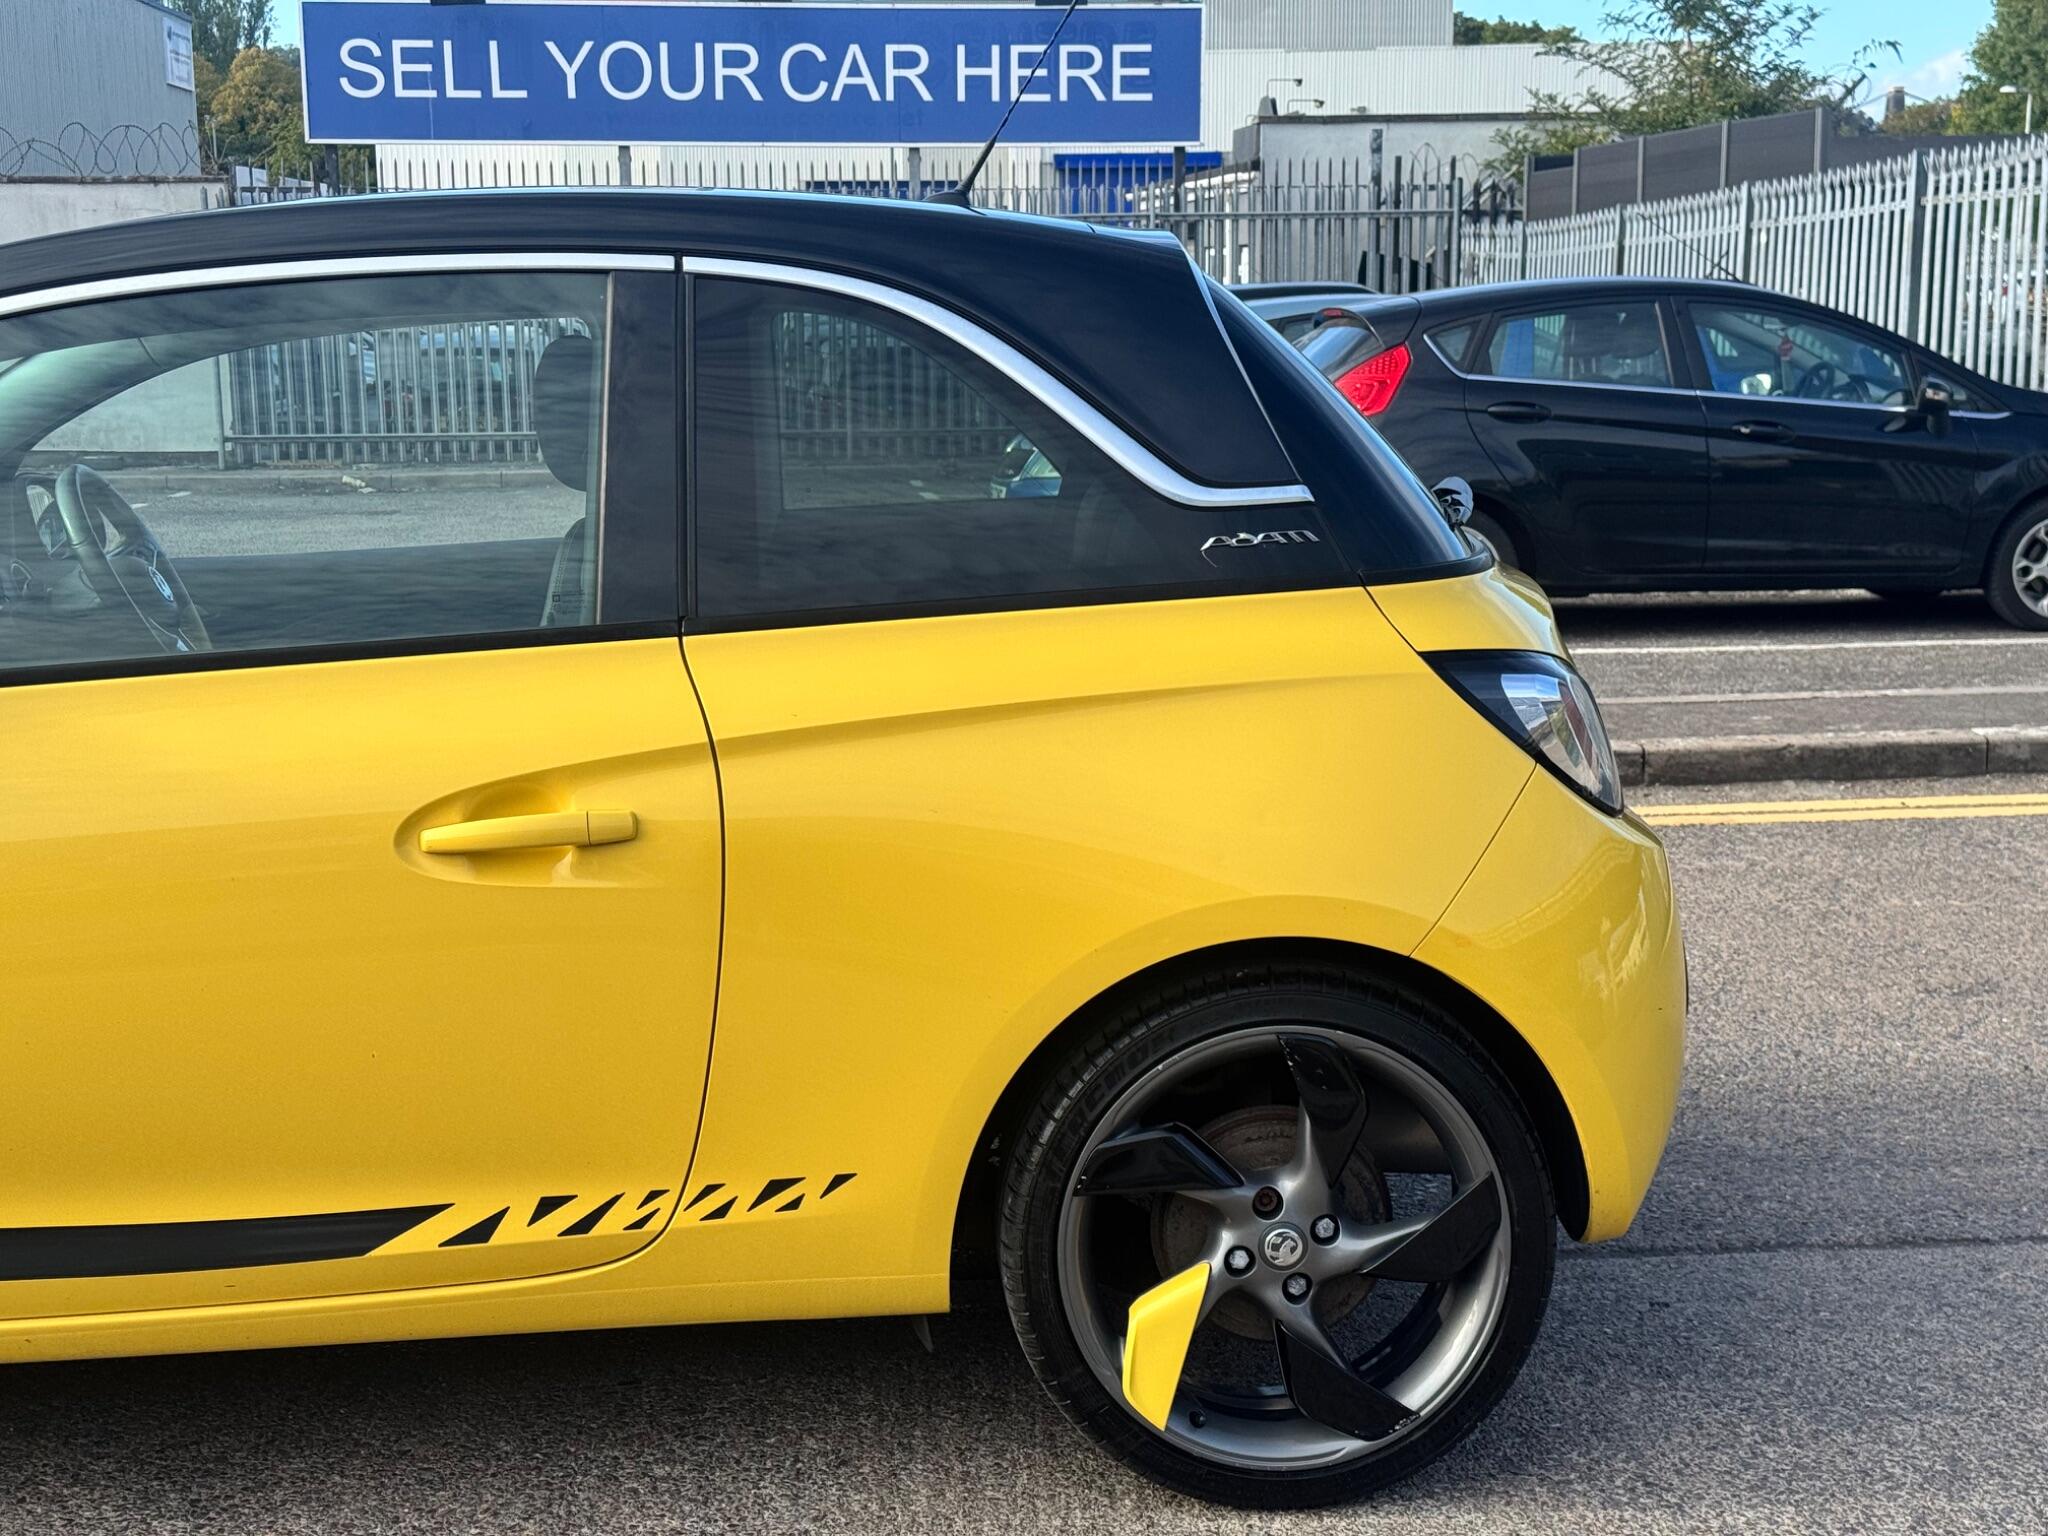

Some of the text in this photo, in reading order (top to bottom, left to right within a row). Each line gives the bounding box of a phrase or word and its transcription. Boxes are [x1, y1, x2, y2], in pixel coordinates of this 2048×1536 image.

[339, 38, 1154, 102] SELL YOUR CAR HERE
